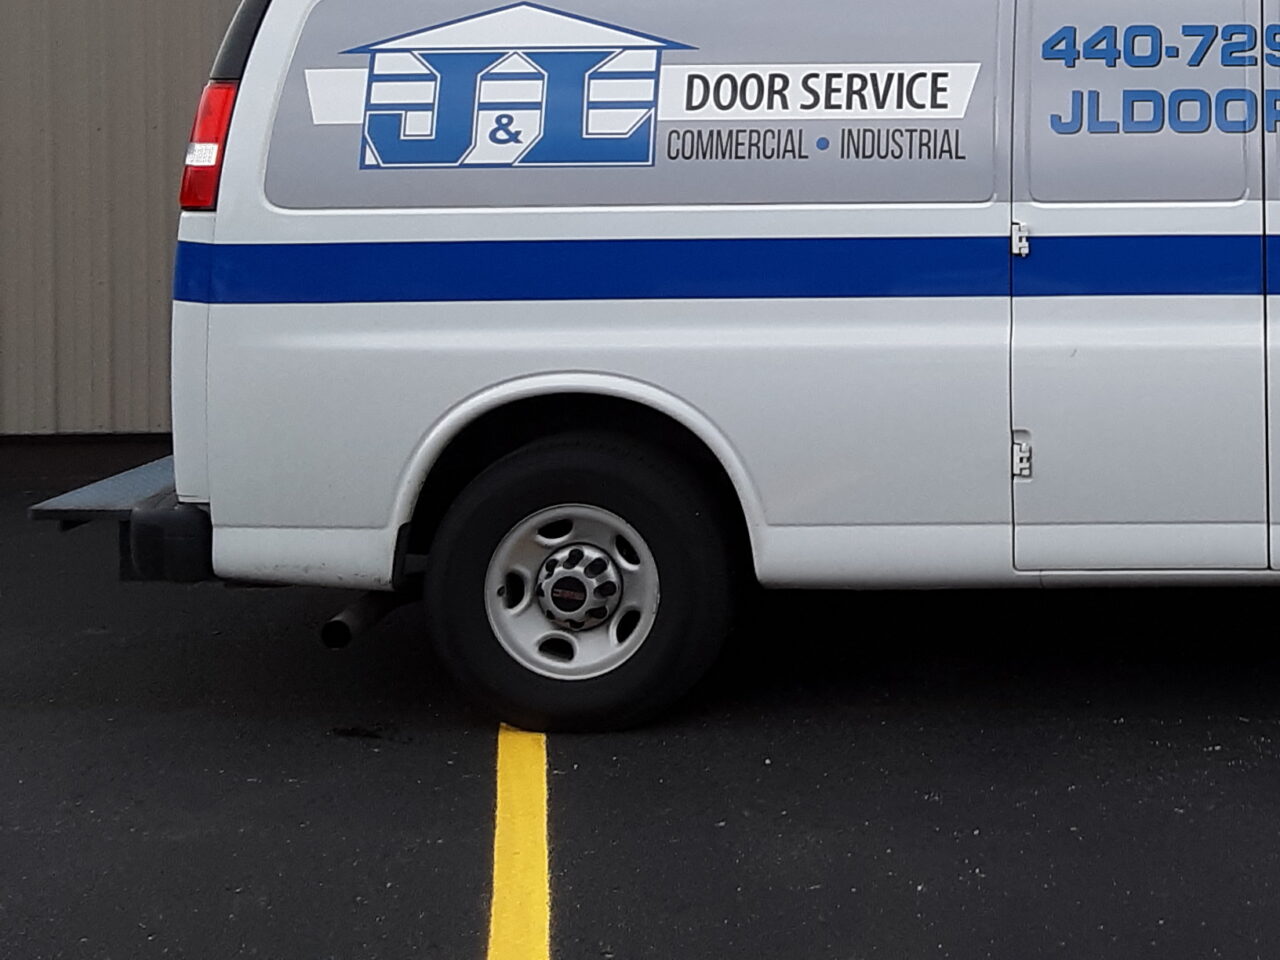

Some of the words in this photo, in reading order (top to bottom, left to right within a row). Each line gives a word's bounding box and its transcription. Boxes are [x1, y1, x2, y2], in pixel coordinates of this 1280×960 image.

[685, 73, 790, 112] DOOR
[799, 72, 949, 111] SERVICE
[666, 129, 809, 160] COMMERCIAL
[840, 128, 966, 160] INDUSTRIAL
